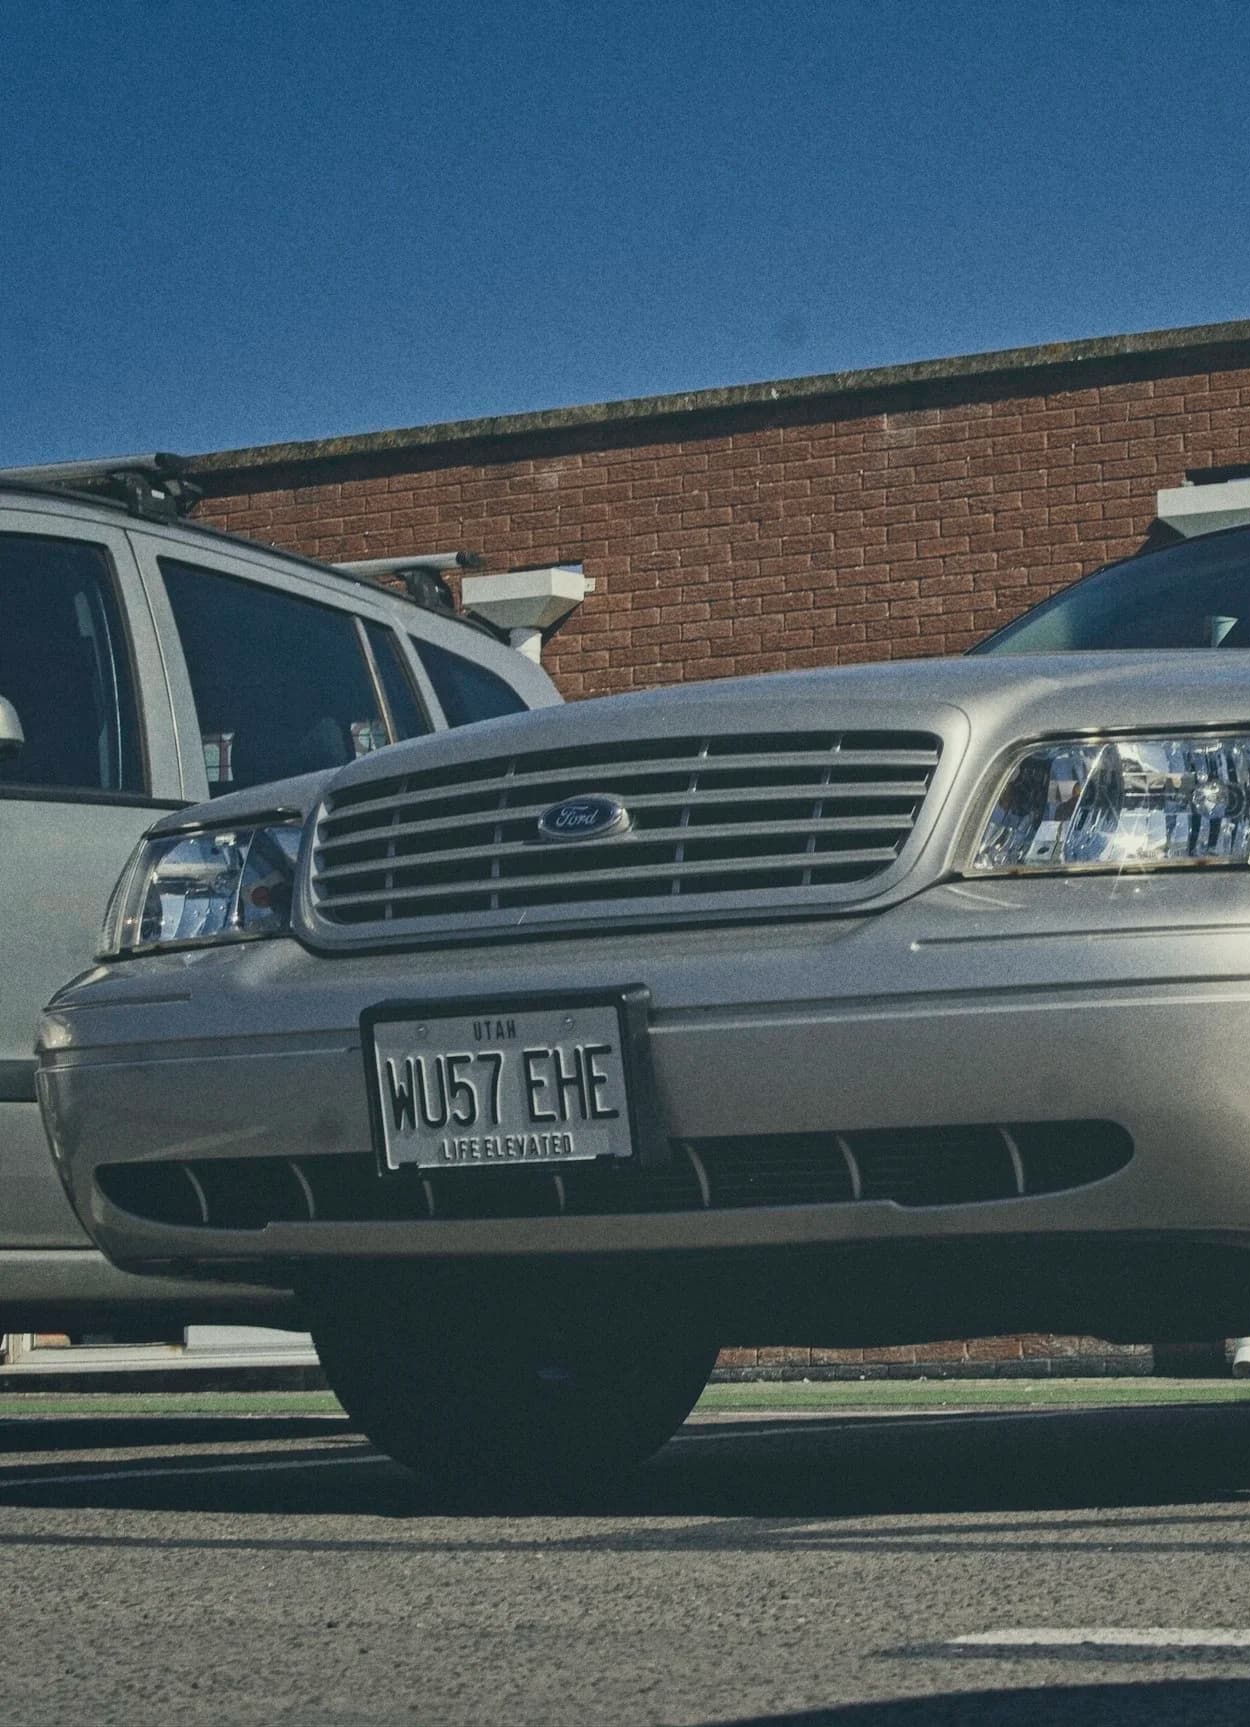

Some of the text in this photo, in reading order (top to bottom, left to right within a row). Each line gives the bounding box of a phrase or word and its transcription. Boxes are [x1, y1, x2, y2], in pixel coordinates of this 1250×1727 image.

[556, 806, 599, 827] Ford
[473, 1019, 517, 1041] UTAH
[386, 1044, 620, 1131] WU57 EHE
[442, 1132, 575, 1160] LIFE ELEVATED
